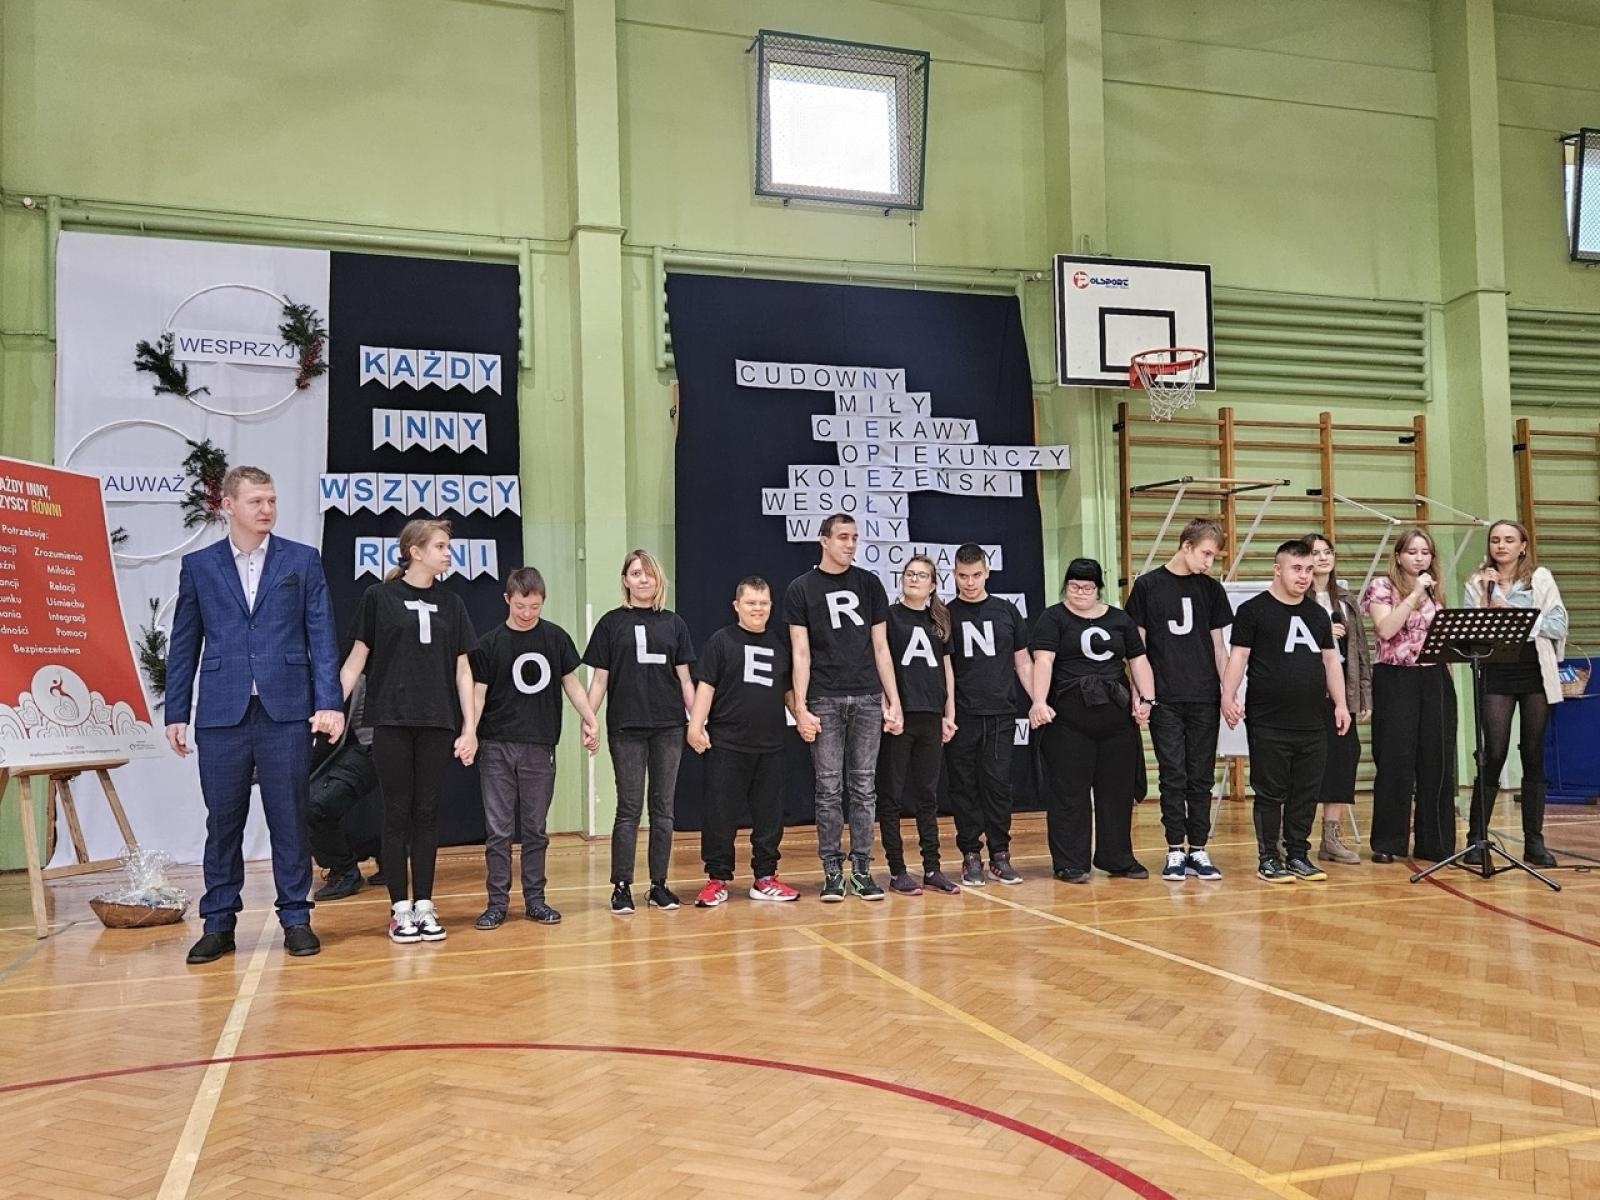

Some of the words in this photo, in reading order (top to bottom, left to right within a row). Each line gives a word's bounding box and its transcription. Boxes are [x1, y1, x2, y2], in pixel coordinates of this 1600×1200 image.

[179, 337, 295, 360] WESPRZYJ
[364, 351, 498, 381] KAŻDY
[740, 365, 901, 390] CUDOWNY
[839, 395, 926, 414] MIŁY
[384, 415, 483, 441] INNY
[816, 419, 972, 442] CIEKAWY
[841, 444, 1066, 467] OPIEKUŃCZY
[102, 474, 186, 493] AUWAŻ
[320, 478, 516, 503] WSZYSCY
[794, 468, 1013, 493] KOLEŻEŃSKI
[31, 498, 62, 517] RÓWNI
[764, 492, 903, 514] WESOŁY
[788, 519, 903, 538] WNY
[34, 546, 84, 561] Zrozumienia
[359, 539, 488, 567] RÓNI
[46, 564, 76, 576] Miłości
[48, 580, 76, 594] Relacji
[46, 596, 85, 609] Uśmiechu
[825, 590, 865, 629] R
[48, 611, 86, 624] Integracji
[404, 599, 438, 644] T
[1167, 597, 1193, 636] J
[55, 626, 87, 640] Pomocy
[634, 624, 667, 664] L
[961, 620, 996, 658] N
[1080, 626, 1115, 661] C
[1284, 615, 1322, 653] A
[12, 643, 81, 656] Bezpieczeństwa
[900, 626, 939, 667] A
[512, 652, 551, 694] O
[743, 645, 775, 687] E
